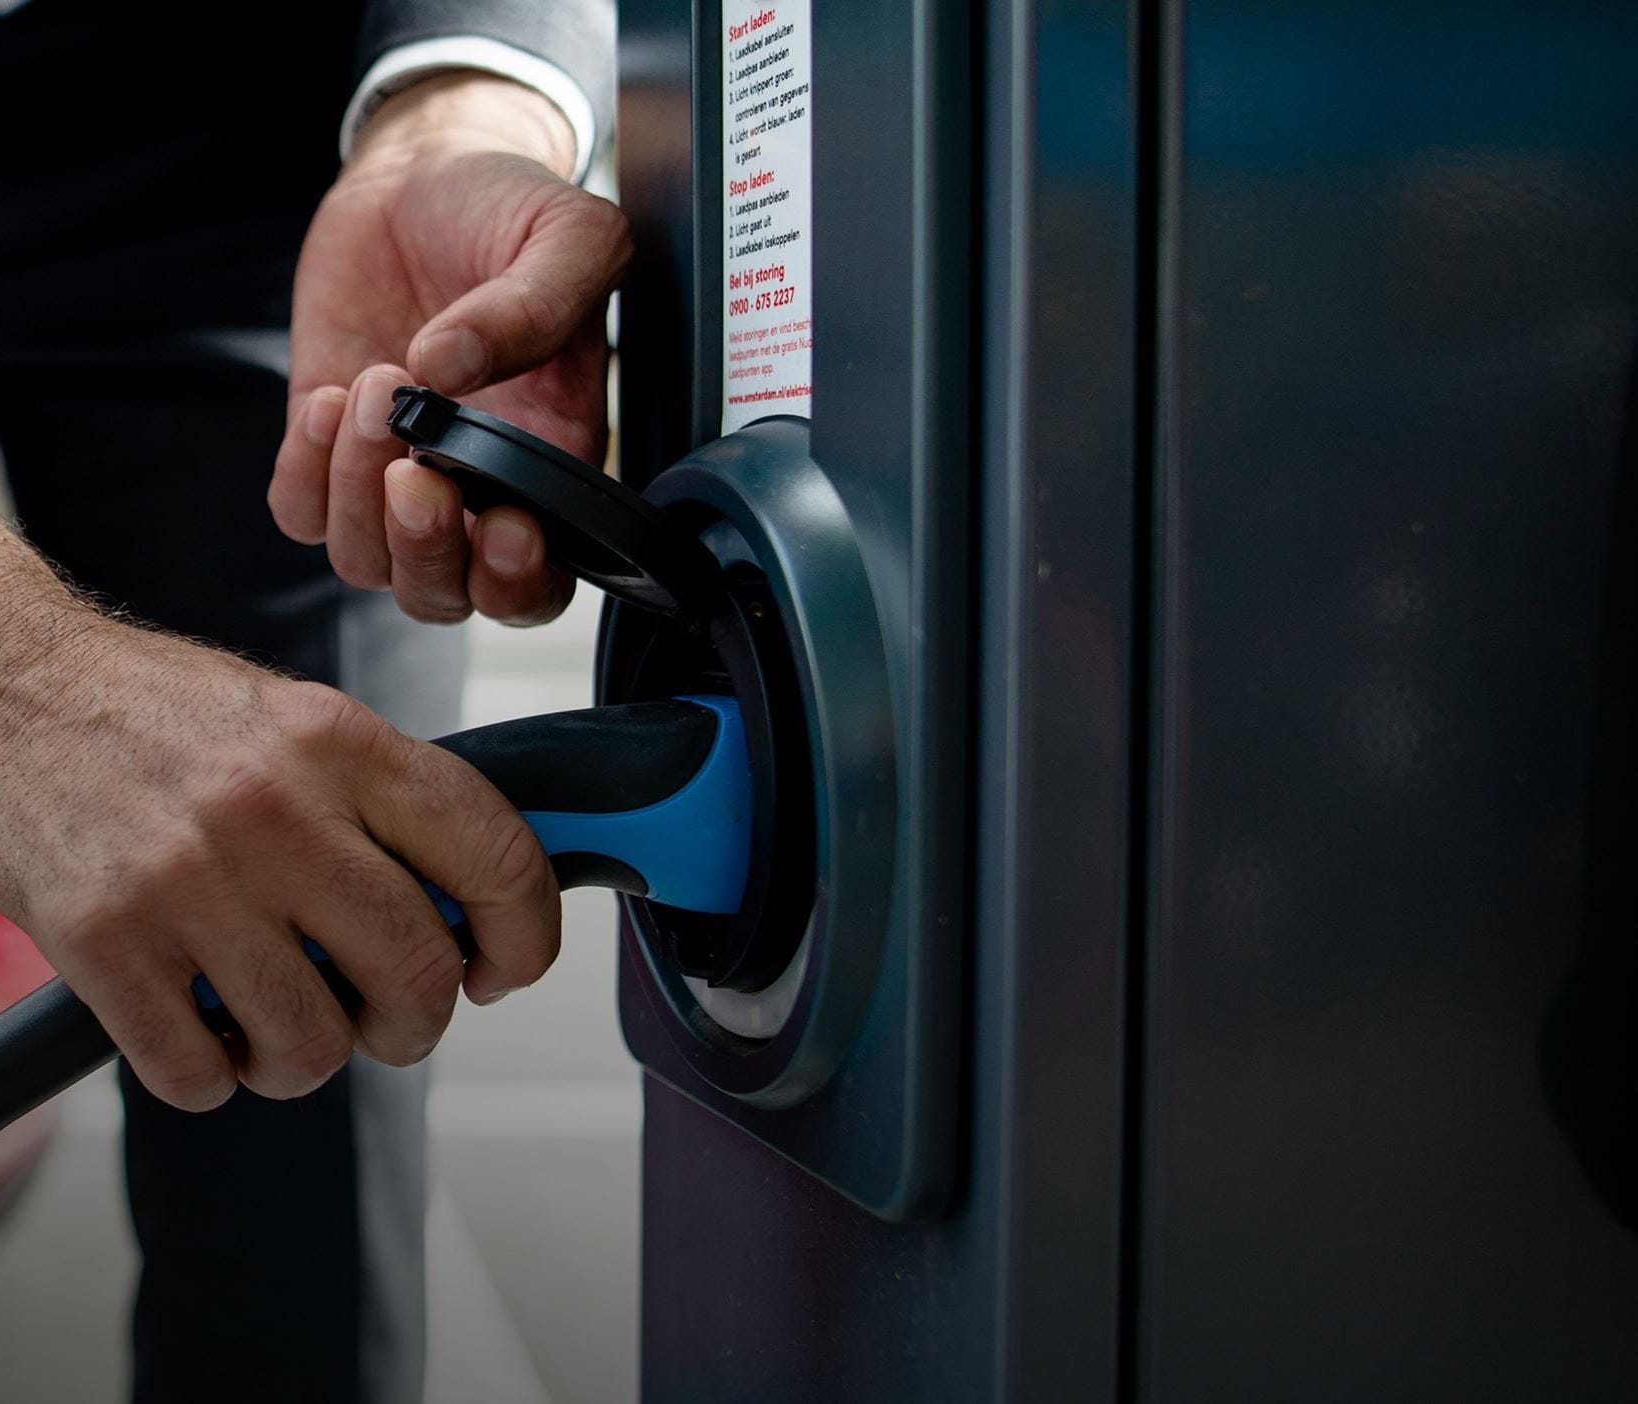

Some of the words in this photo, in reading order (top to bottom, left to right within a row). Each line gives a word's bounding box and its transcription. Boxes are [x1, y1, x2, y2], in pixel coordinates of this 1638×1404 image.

[729, 20, 748, 42] Start
[750, 9, 776, 32] laden:
[735, 35, 764, 60] Laadkabel
[764, 24, 794, 46] aansluiten
[735, 64, 758, 81] Laadpas
[759, 48, 789, 70] aanbieden
[735, 88, 748, 101] Licht
[750, 76, 773, 96] knippert
[735, 102, 767, 122] controleren
[768, 96, 778, 108] van
[780, 83, 809, 107] gegevens
[735, 128, 748, 143] Licht
[750, 121, 766, 136] wordt
[788, 105, 805, 121] laden
[741, 145, 761, 166] gestart
[729, 180, 747, 197] Stop
[750, 169, 775, 190] laden:
[735, 200, 758, 215] Laadpas
[759, 187, 789, 208] aanbieden
[735, 223, 748, 237] Licht
[750, 219, 762, 235] gaat
[764, 214, 772, 228] uit
[735, 237, 764, 257] Laadkabel
[764, 228, 800, 249] loskoppelen
[729, 271, 741, 290] Bel
[743, 268, 753, 290] bij
[755, 263, 784, 283] storing
[729, 298, 749, 317] 0900
[755, 292, 771, 311] 675
[773, 286, 795, 307] 2237
[743, 328, 769, 342] storingen
[770, 326, 778, 336] en
[779, 320, 791, 334] vind
[760, 345, 771, 355] met
[772, 341, 780, 354] de
[781, 339, 797, 356] gratis
